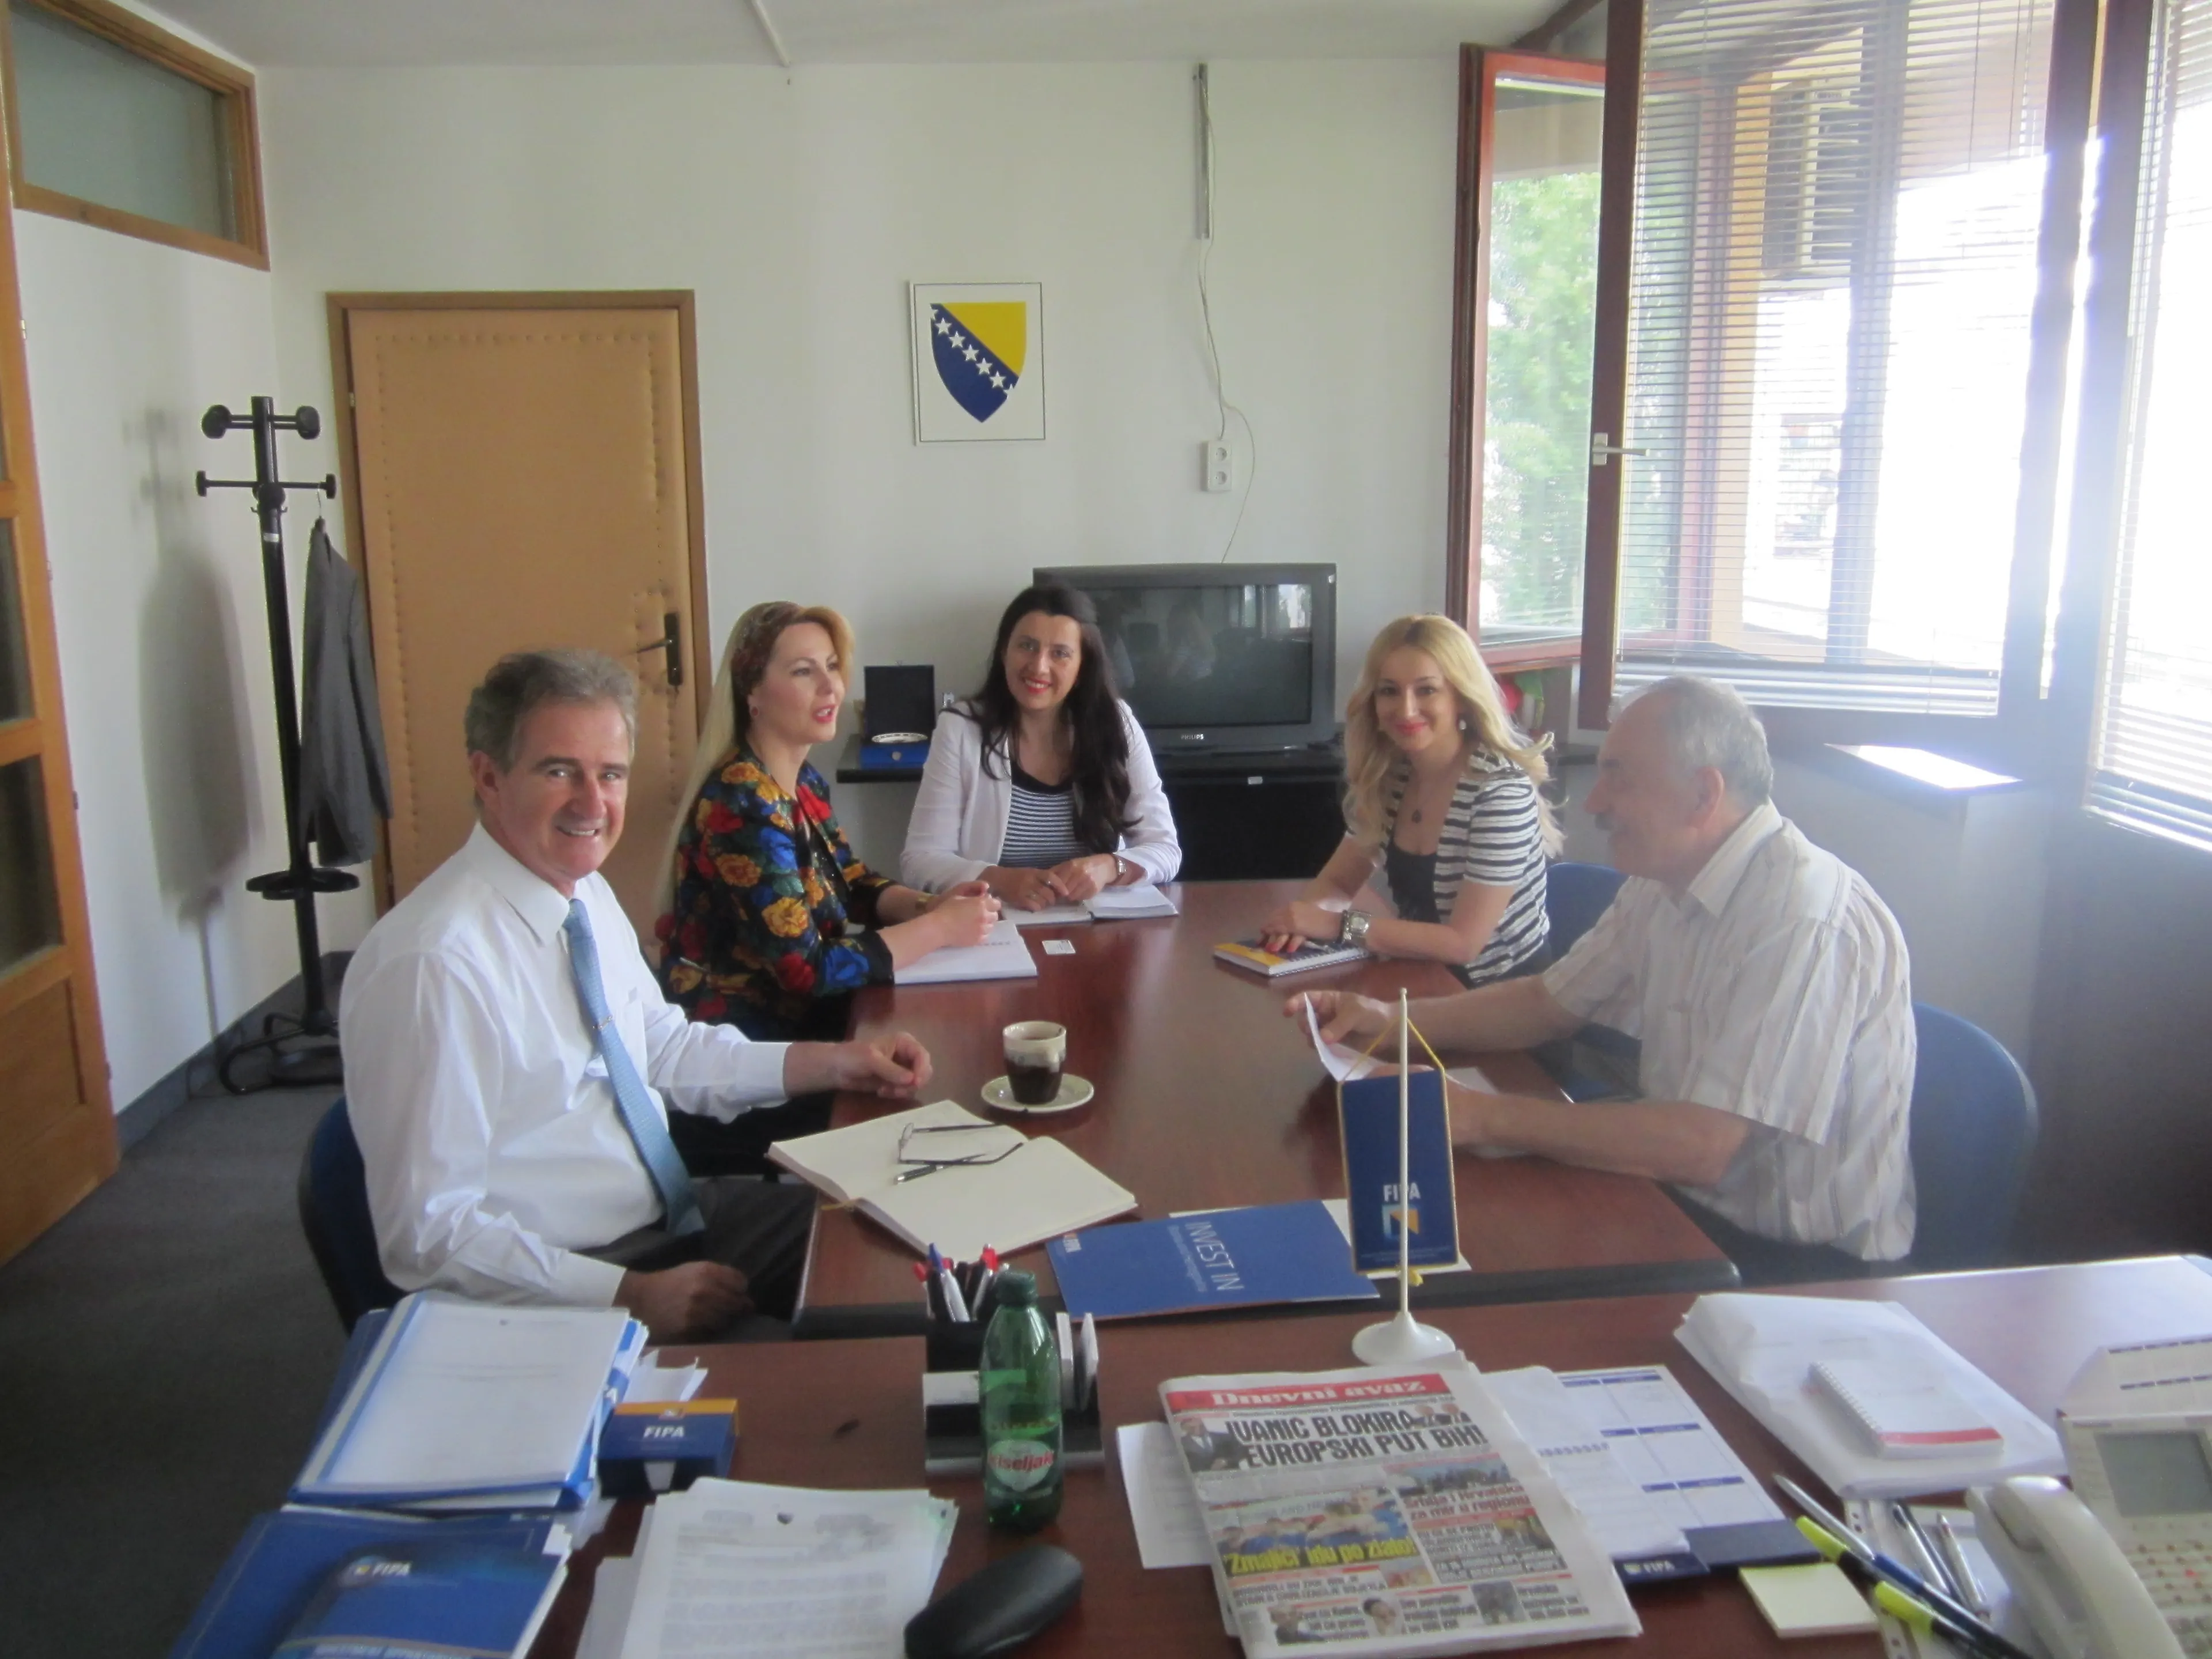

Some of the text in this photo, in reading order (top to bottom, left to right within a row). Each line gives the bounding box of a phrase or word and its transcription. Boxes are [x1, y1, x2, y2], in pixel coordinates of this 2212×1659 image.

[1384, 1182, 1421, 1202] FIA
[1184, 1221, 1234, 1269] INVEST
[1210, 1272, 1245, 1290] IN
[1212, 1387, 1338, 1406] Dnevni
[1345, 1381, 1426, 1396] avaz
[643, 1425, 684, 1438] FIPA
[1311, 1410, 1412, 1438] BLOKIRA
[1373, 1431, 1429, 1454] PUT
[372, 1562, 410, 1577] FIPA
